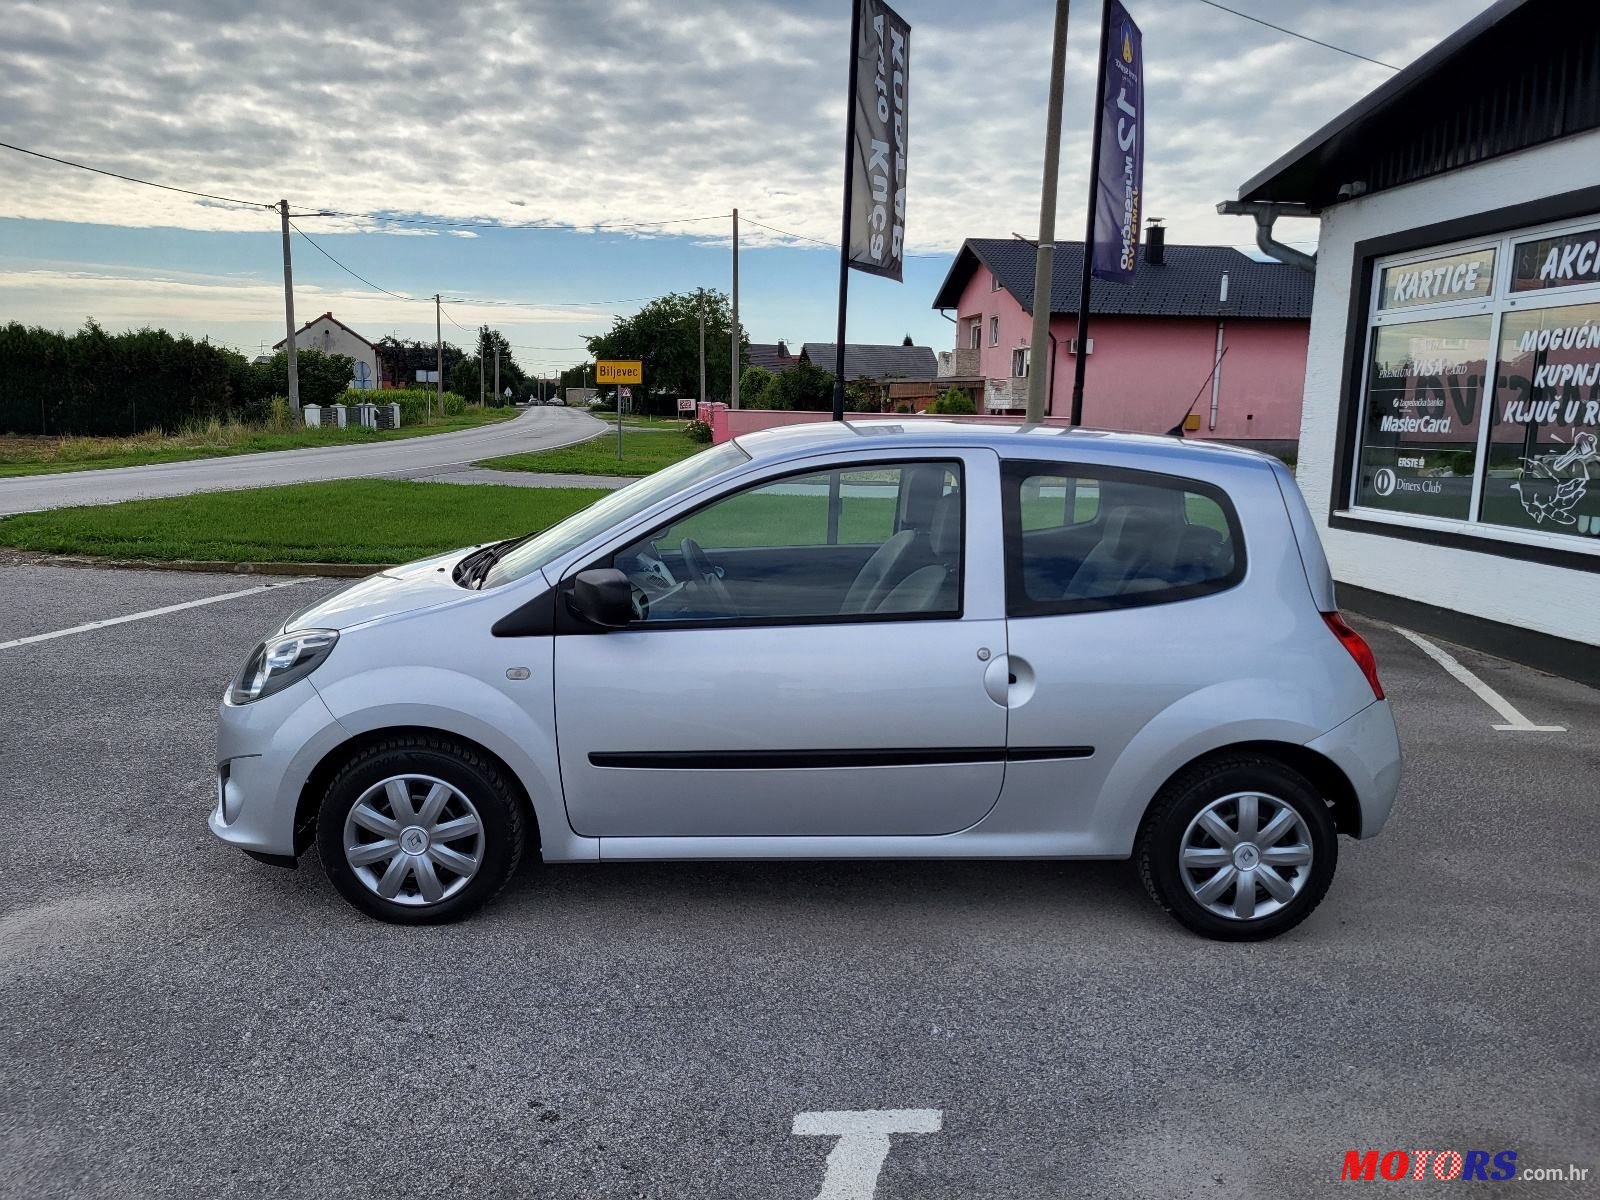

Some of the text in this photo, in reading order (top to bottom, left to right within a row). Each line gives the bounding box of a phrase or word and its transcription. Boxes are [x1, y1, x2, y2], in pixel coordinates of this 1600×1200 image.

[1393, 261, 1481, 302] KARTICE
[600, 365, 638, 379] Biljevec
[1378, 358, 1468, 379] PREMIUM VISA CARD
[1503, 395, 1563, 424] KLJUČ
[1564, 399, 1581, 424] U
[1380, 415, 1451, 433] MasterCard
[1397, 457, 1419, 469] ERSTE
[1396, 478, 1442, 494] Diners Club
